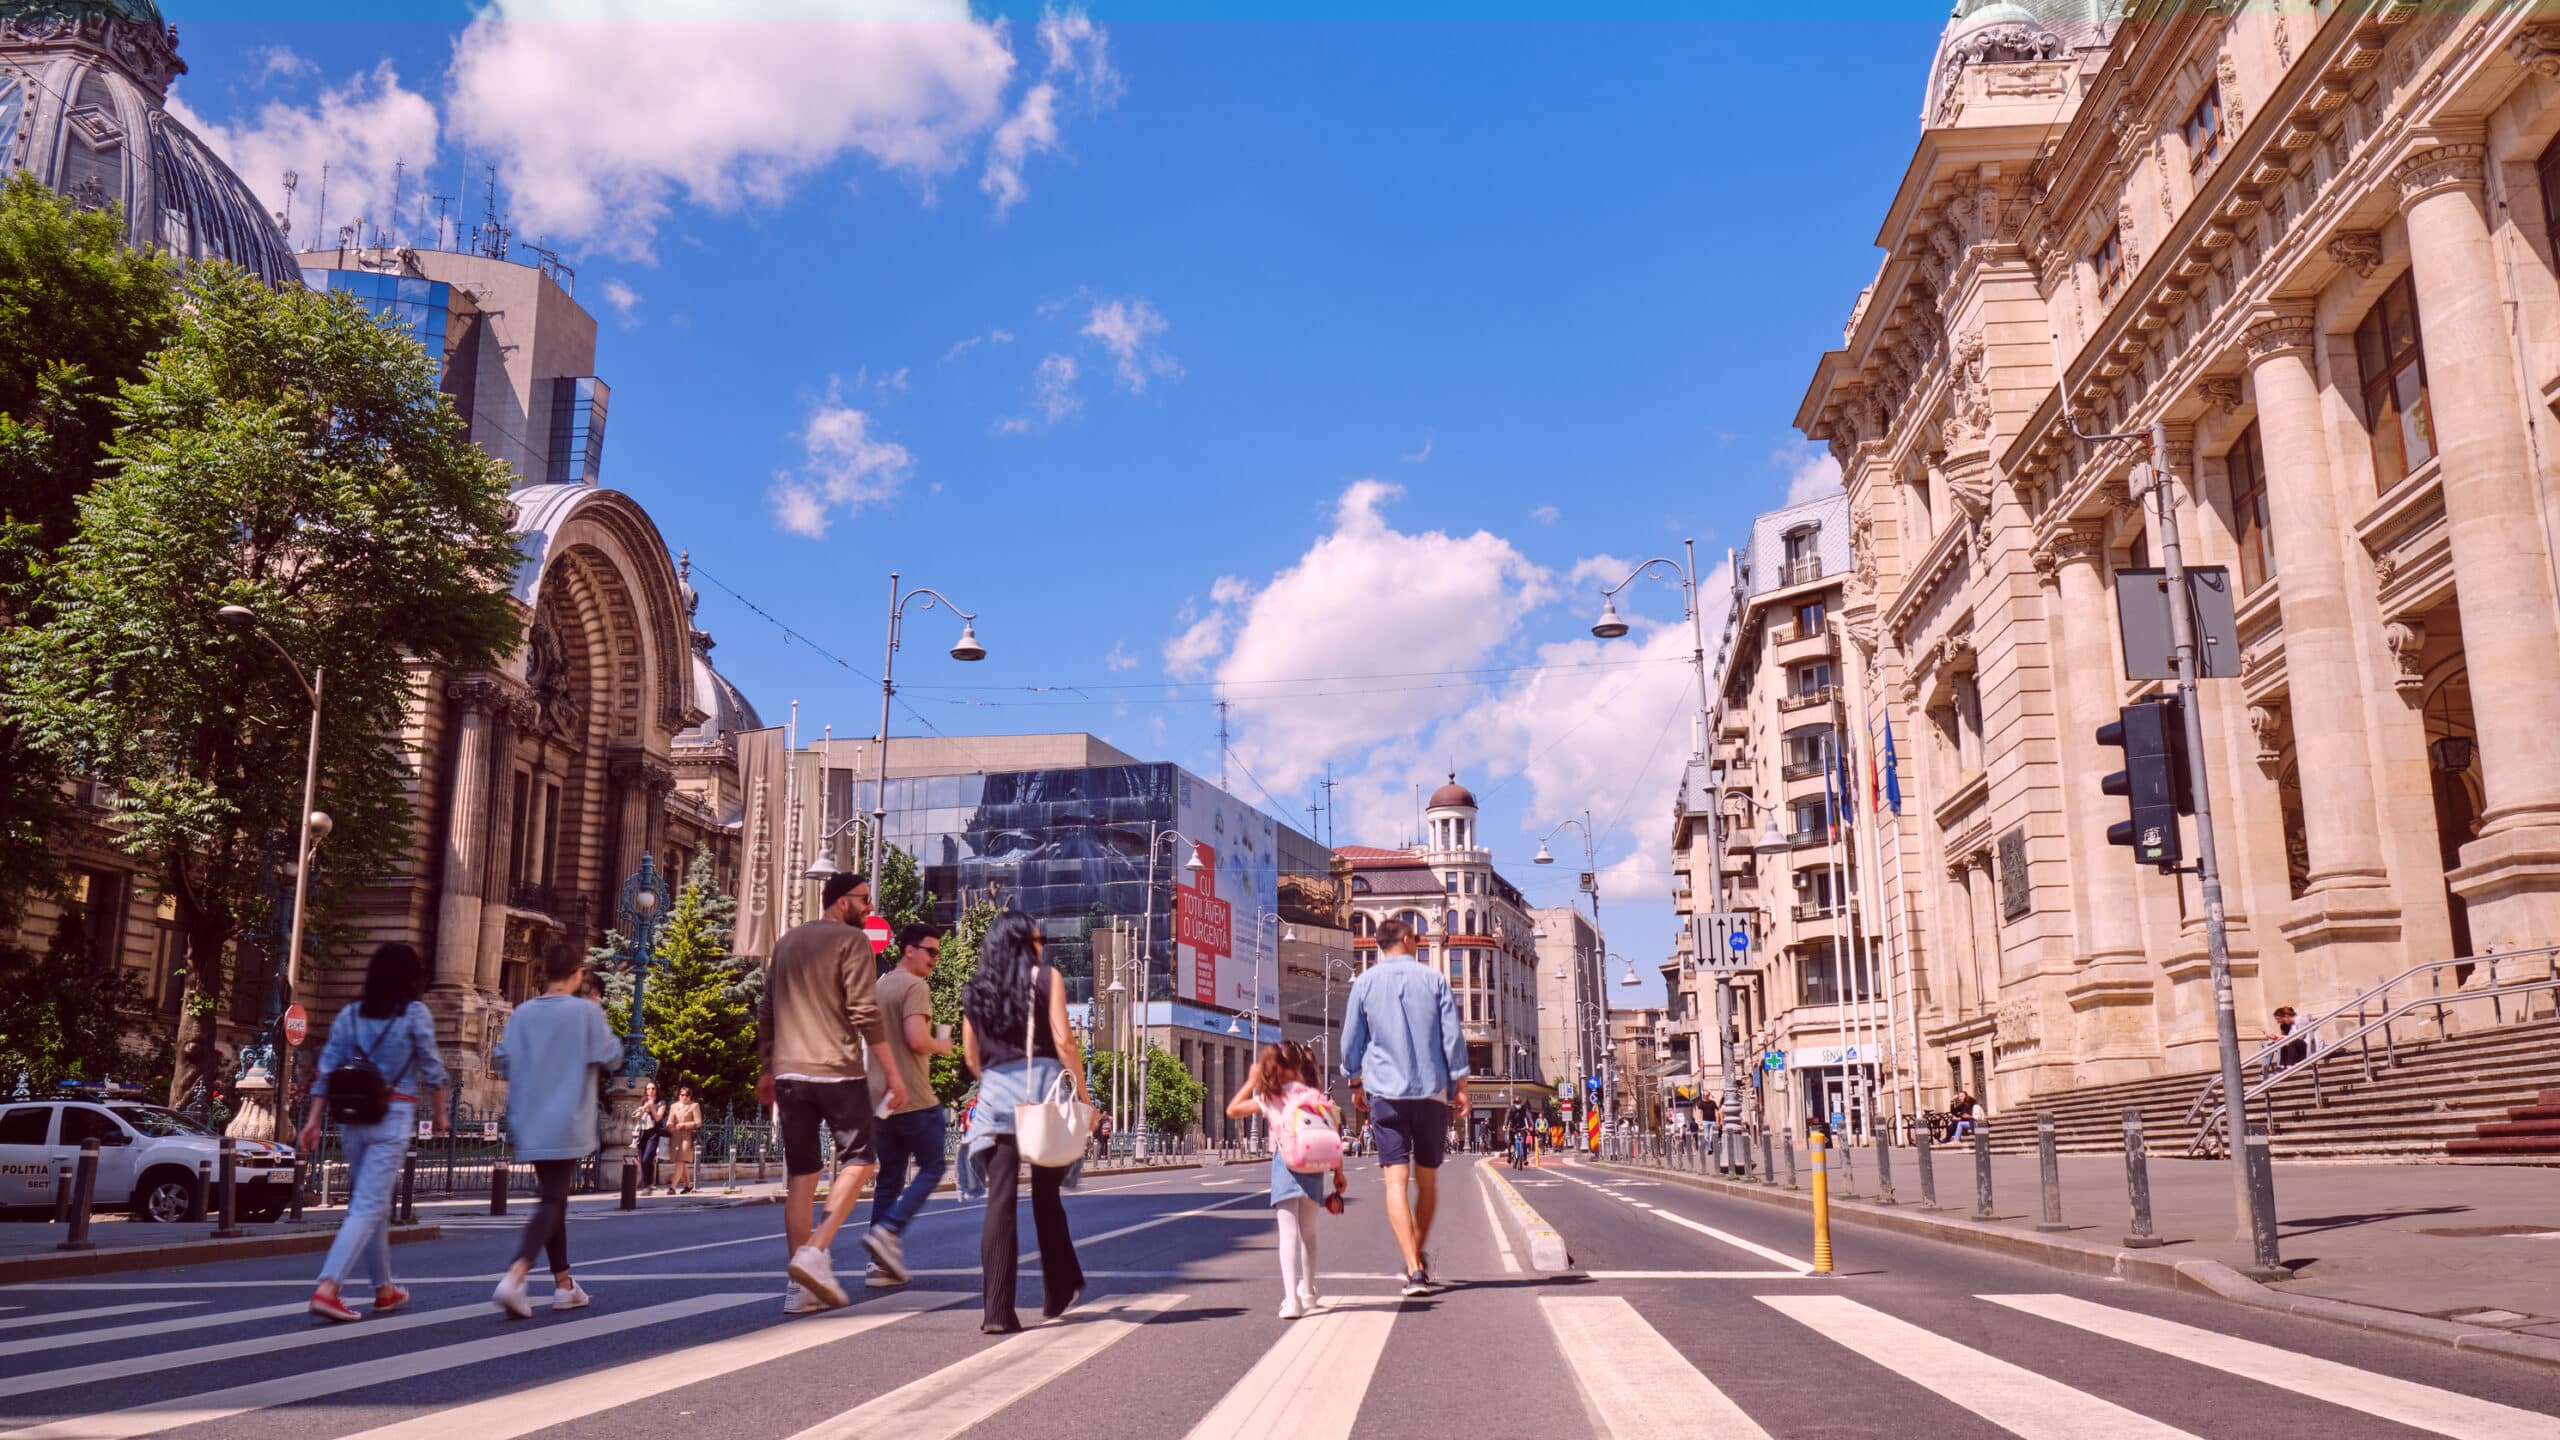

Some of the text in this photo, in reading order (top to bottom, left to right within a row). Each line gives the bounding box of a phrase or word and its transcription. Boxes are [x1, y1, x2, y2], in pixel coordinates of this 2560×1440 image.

[751, 868, 768, 917] CEC
[1200, 874, 1211, 897] CU
[789, 884, 803, 928] CEC
[1183, 917, 1190, 937] O
